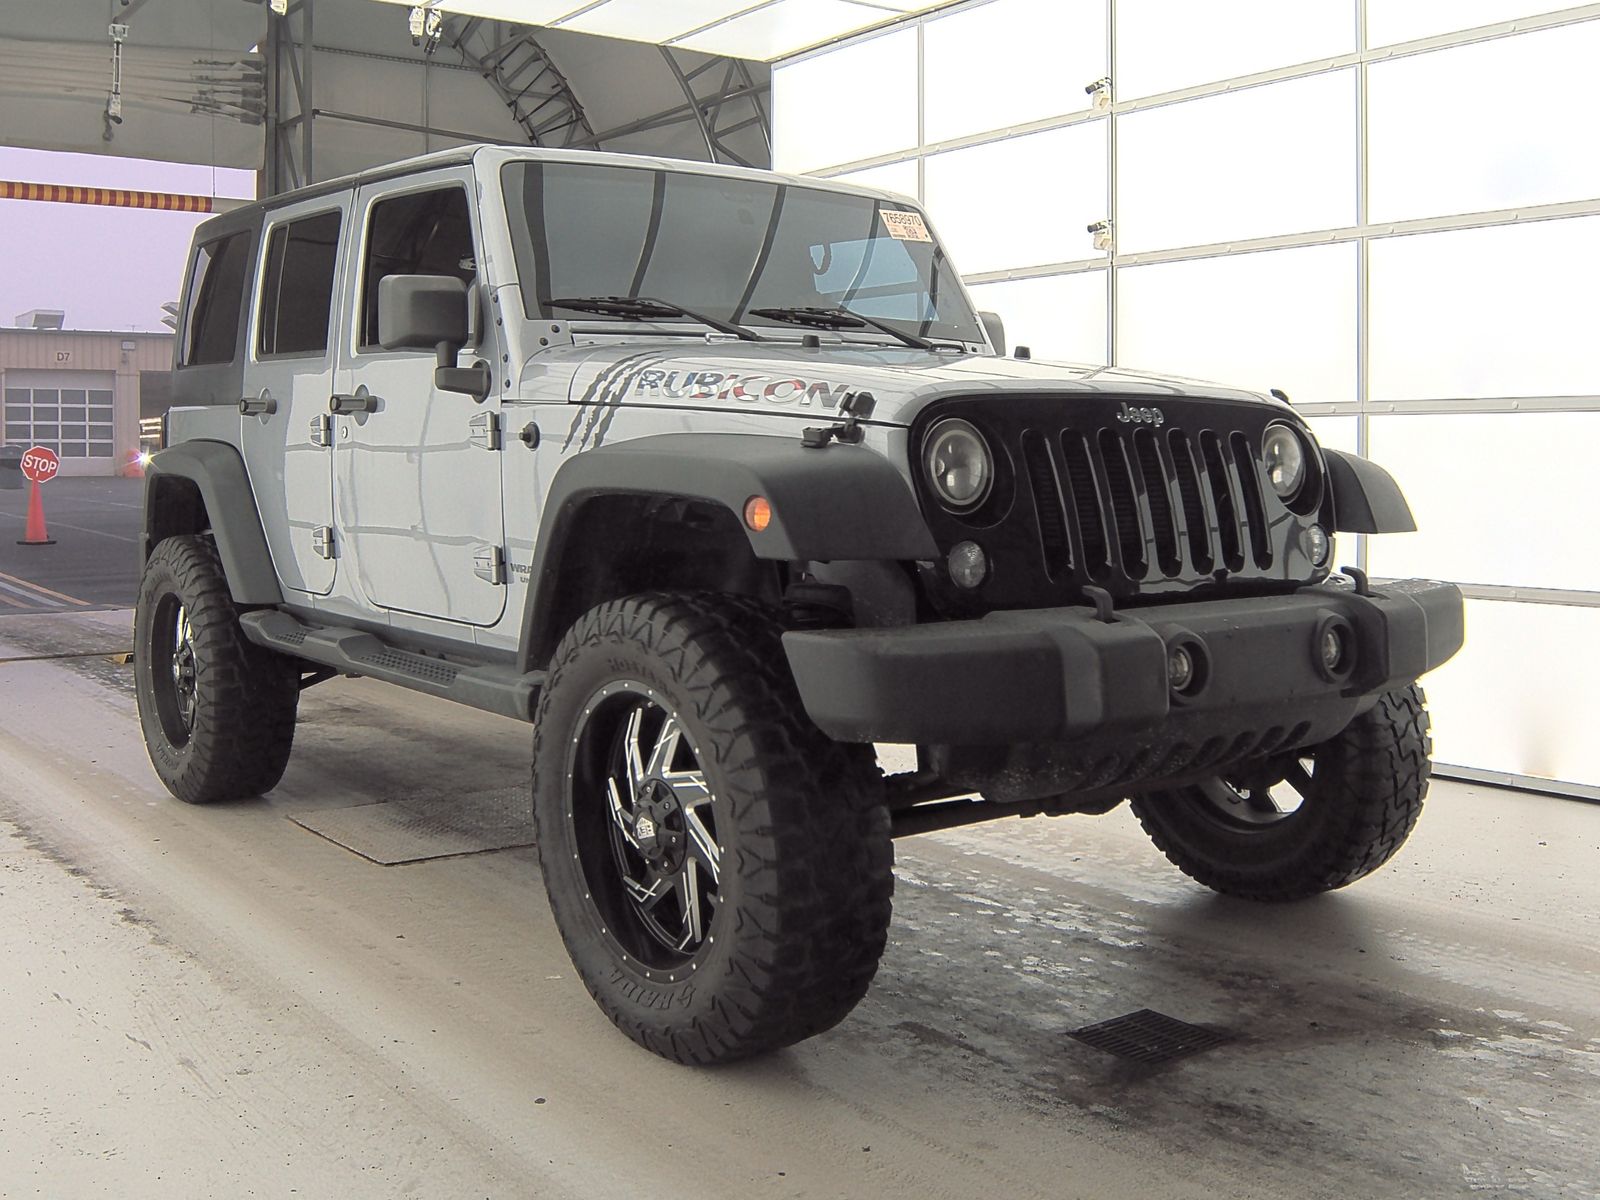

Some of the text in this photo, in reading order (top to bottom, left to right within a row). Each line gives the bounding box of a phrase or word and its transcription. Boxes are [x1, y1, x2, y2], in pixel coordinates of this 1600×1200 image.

[56, 352, 70, 361] D7
[634, 369, 849, 410] RUBICON
[1116, 402, 1164, 427] Jeep
[23, 455, 57, 473] STOP
